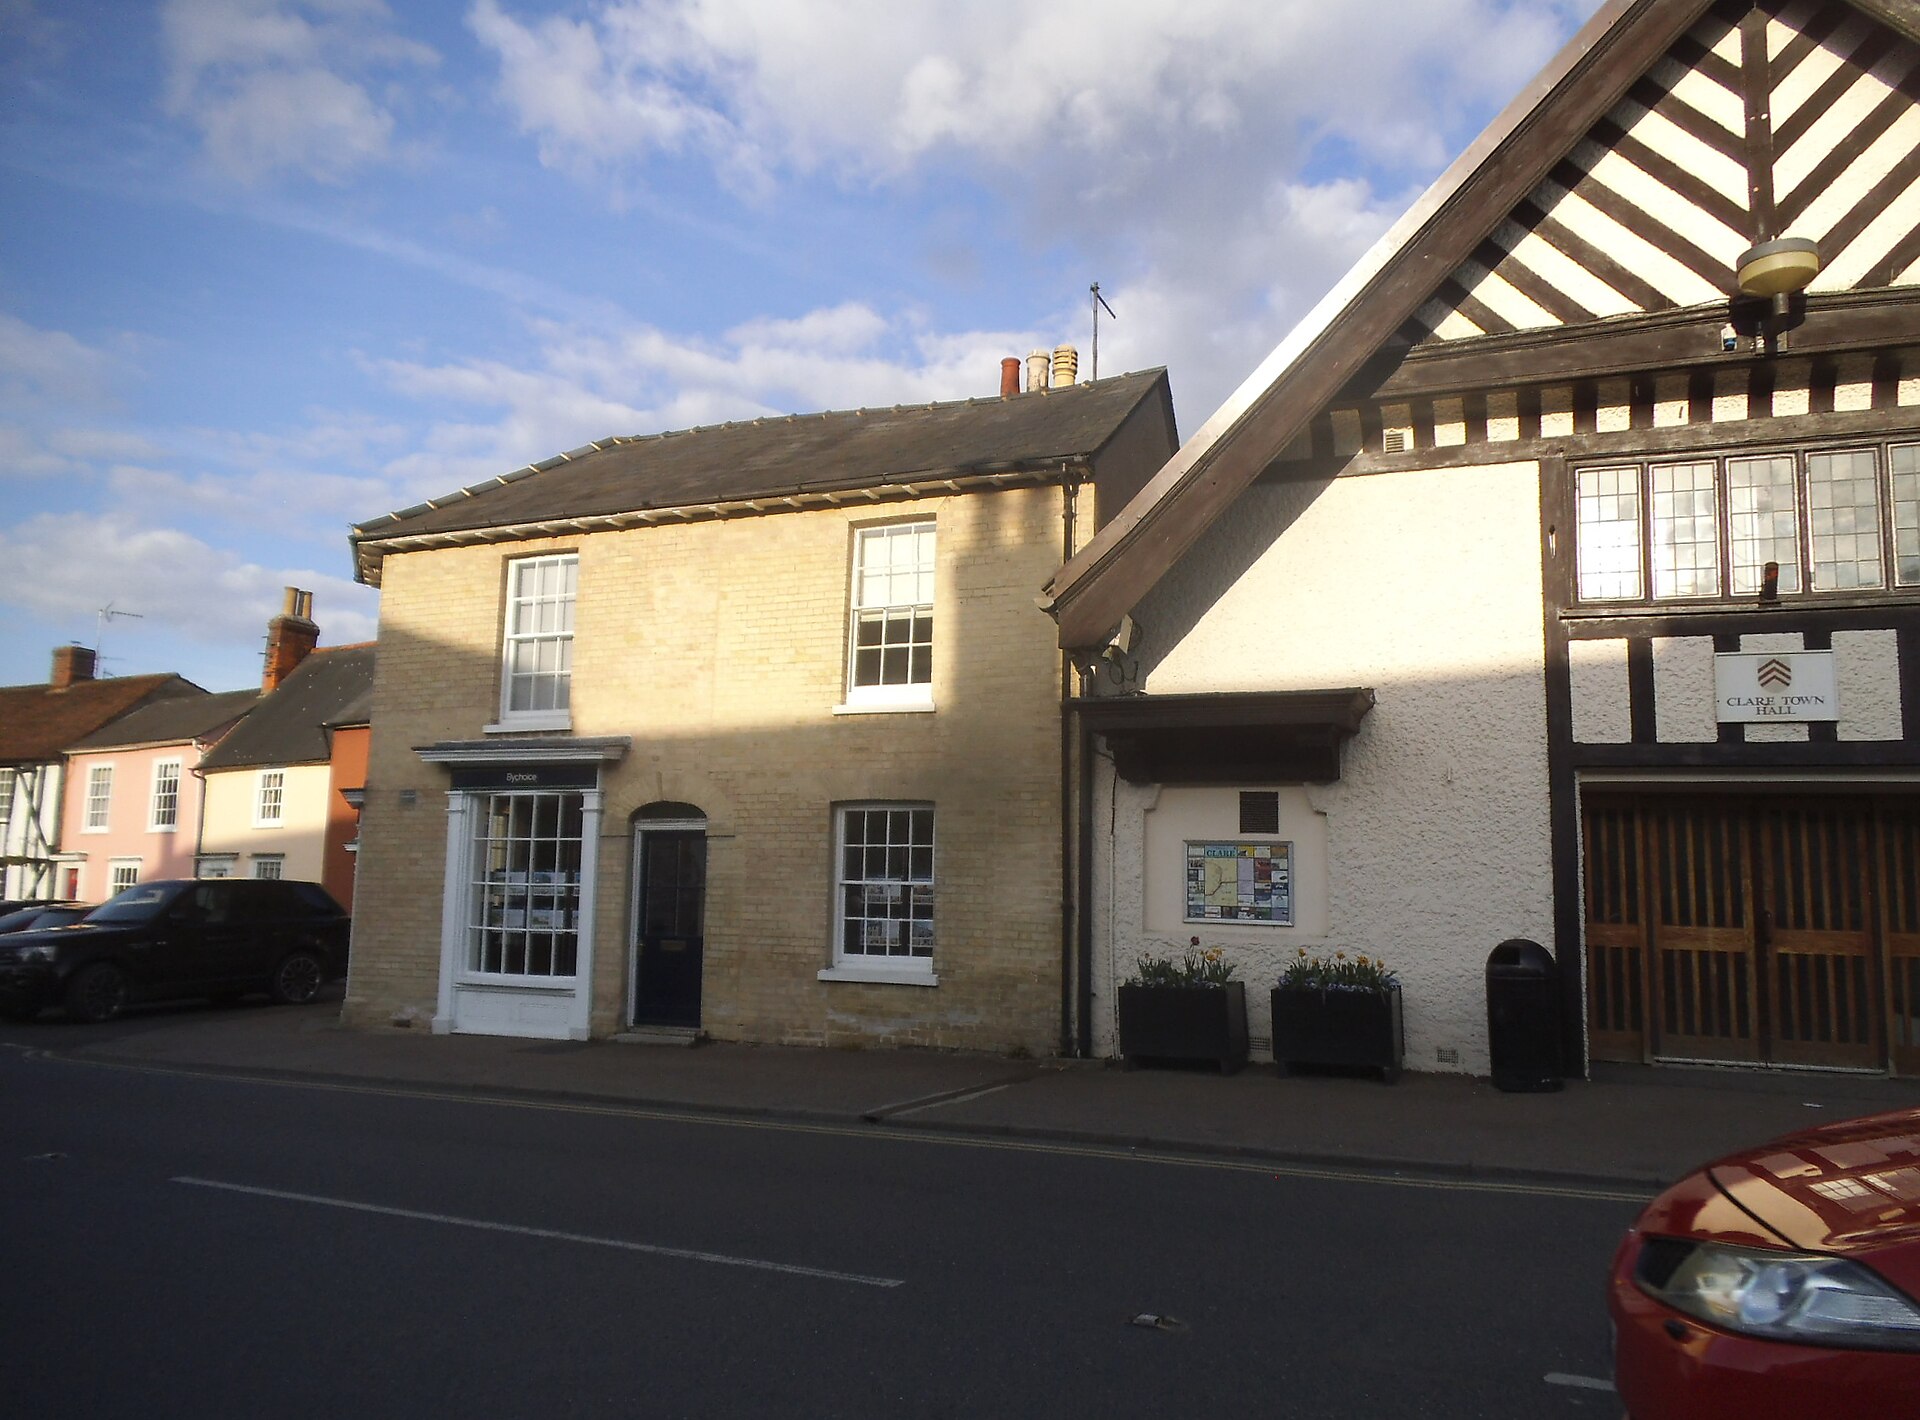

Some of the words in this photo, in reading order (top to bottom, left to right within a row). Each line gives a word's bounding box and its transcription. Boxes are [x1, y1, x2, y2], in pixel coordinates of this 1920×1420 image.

[1726, 697, 1775, 706] CLARE
[1781, 696, 1825, 705] TOWN
[1756, 706, 1796, 715] HALL
[1206, 849, 1235, 857] CLARE
